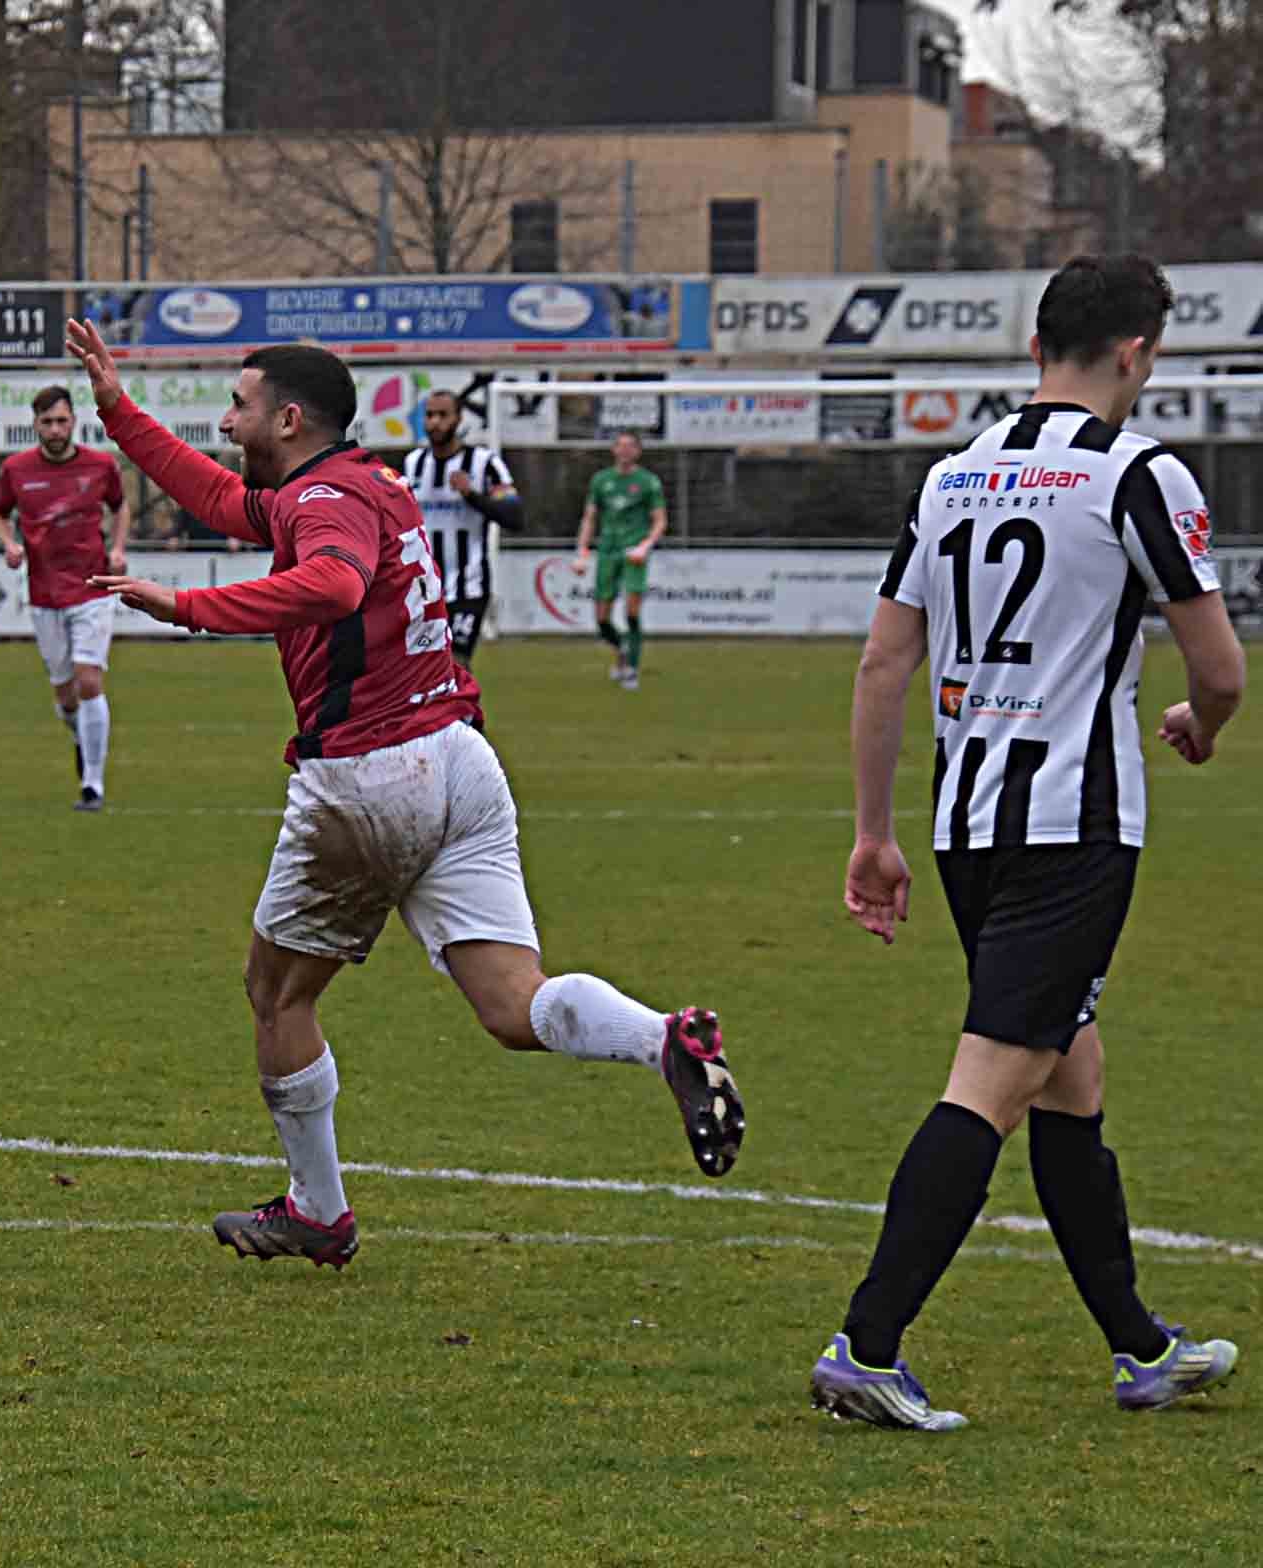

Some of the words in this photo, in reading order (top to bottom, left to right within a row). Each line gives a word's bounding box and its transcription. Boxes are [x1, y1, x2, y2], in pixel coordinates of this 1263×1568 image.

[2, 308, 45, 334] 111
[716, 300, 809, 333] DFDS
[905, 298, 1001, 330] DFDS
[939, 472, 988, 492] Team
[1019, 467, 1091, 489] Wear
[946, 494, 1056, 509] concept
[938, 517, 1046, 664] 12
